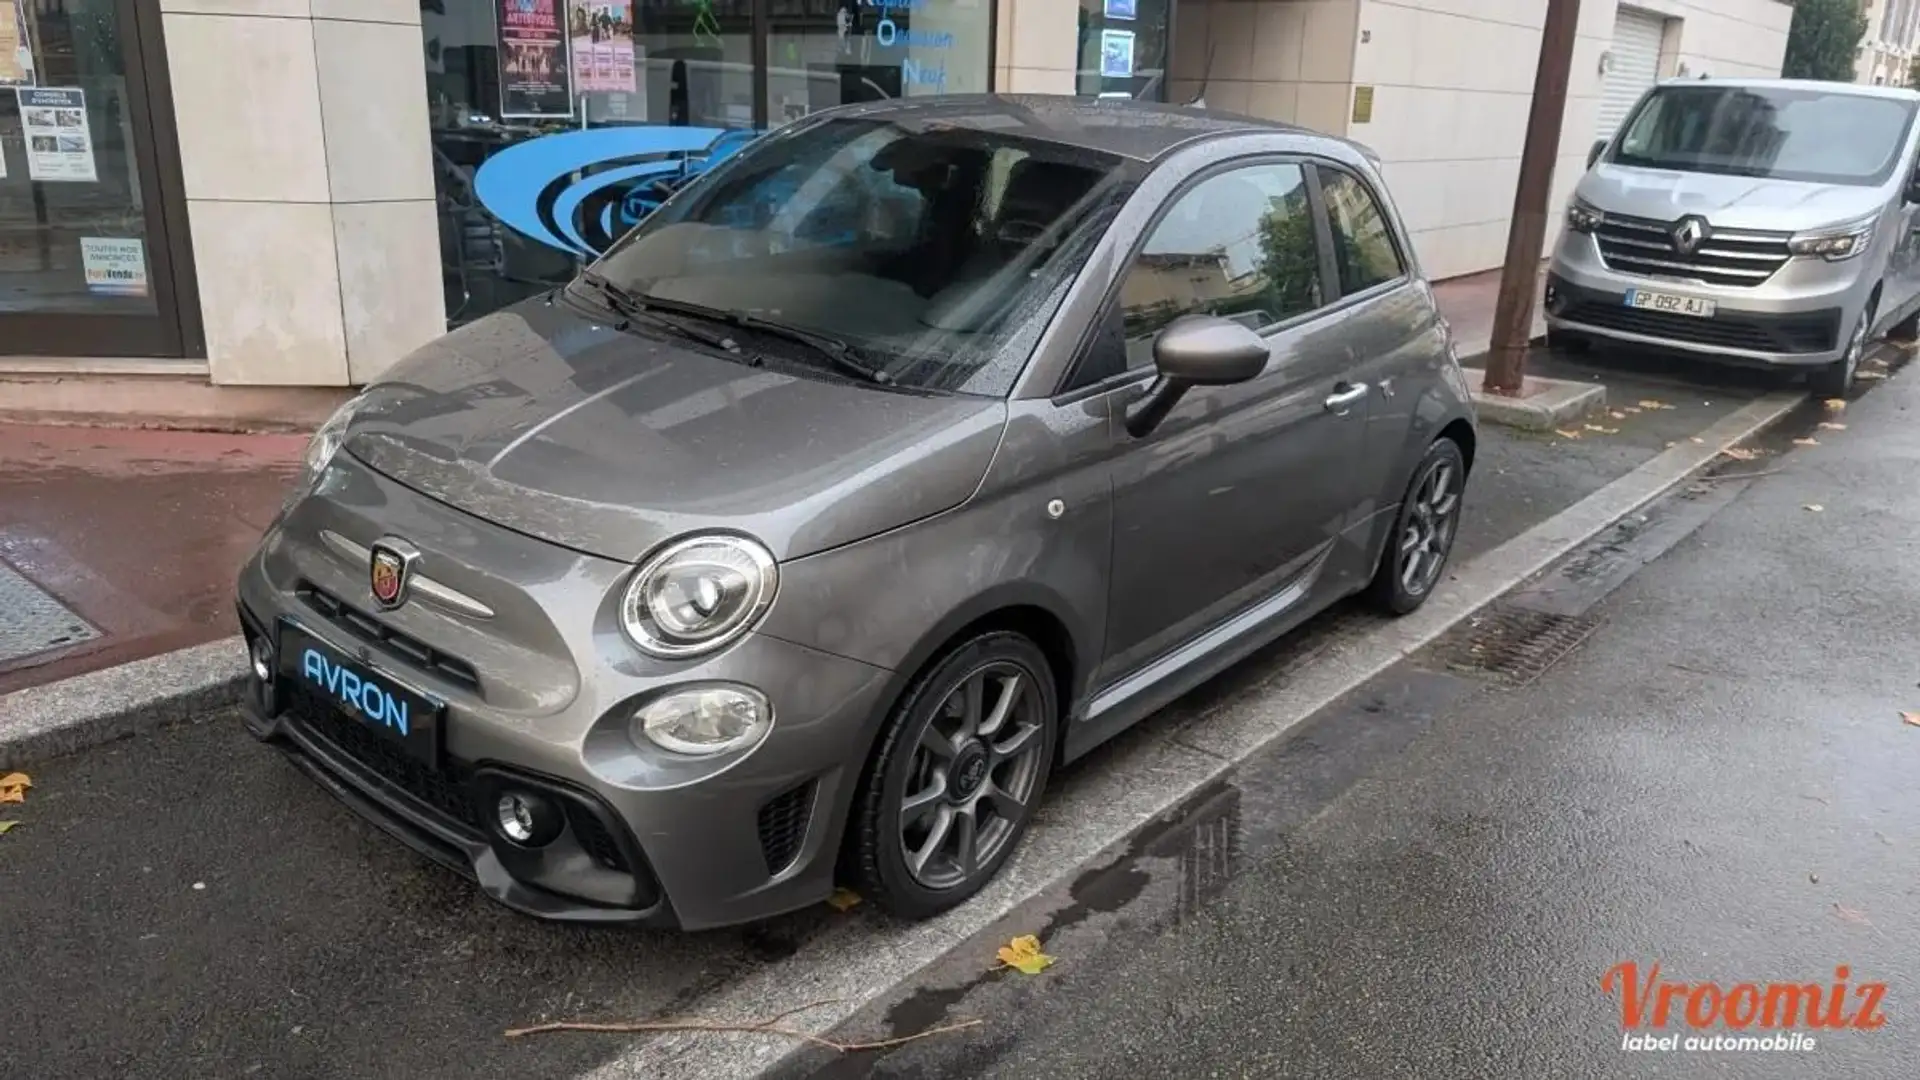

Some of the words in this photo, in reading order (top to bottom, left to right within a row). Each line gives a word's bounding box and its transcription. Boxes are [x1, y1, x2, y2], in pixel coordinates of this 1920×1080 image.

[1635, 291, 1653, 306] GP
[1655, 294, 1681, 311] 092
[303, 648, 409, 737] AVRON
